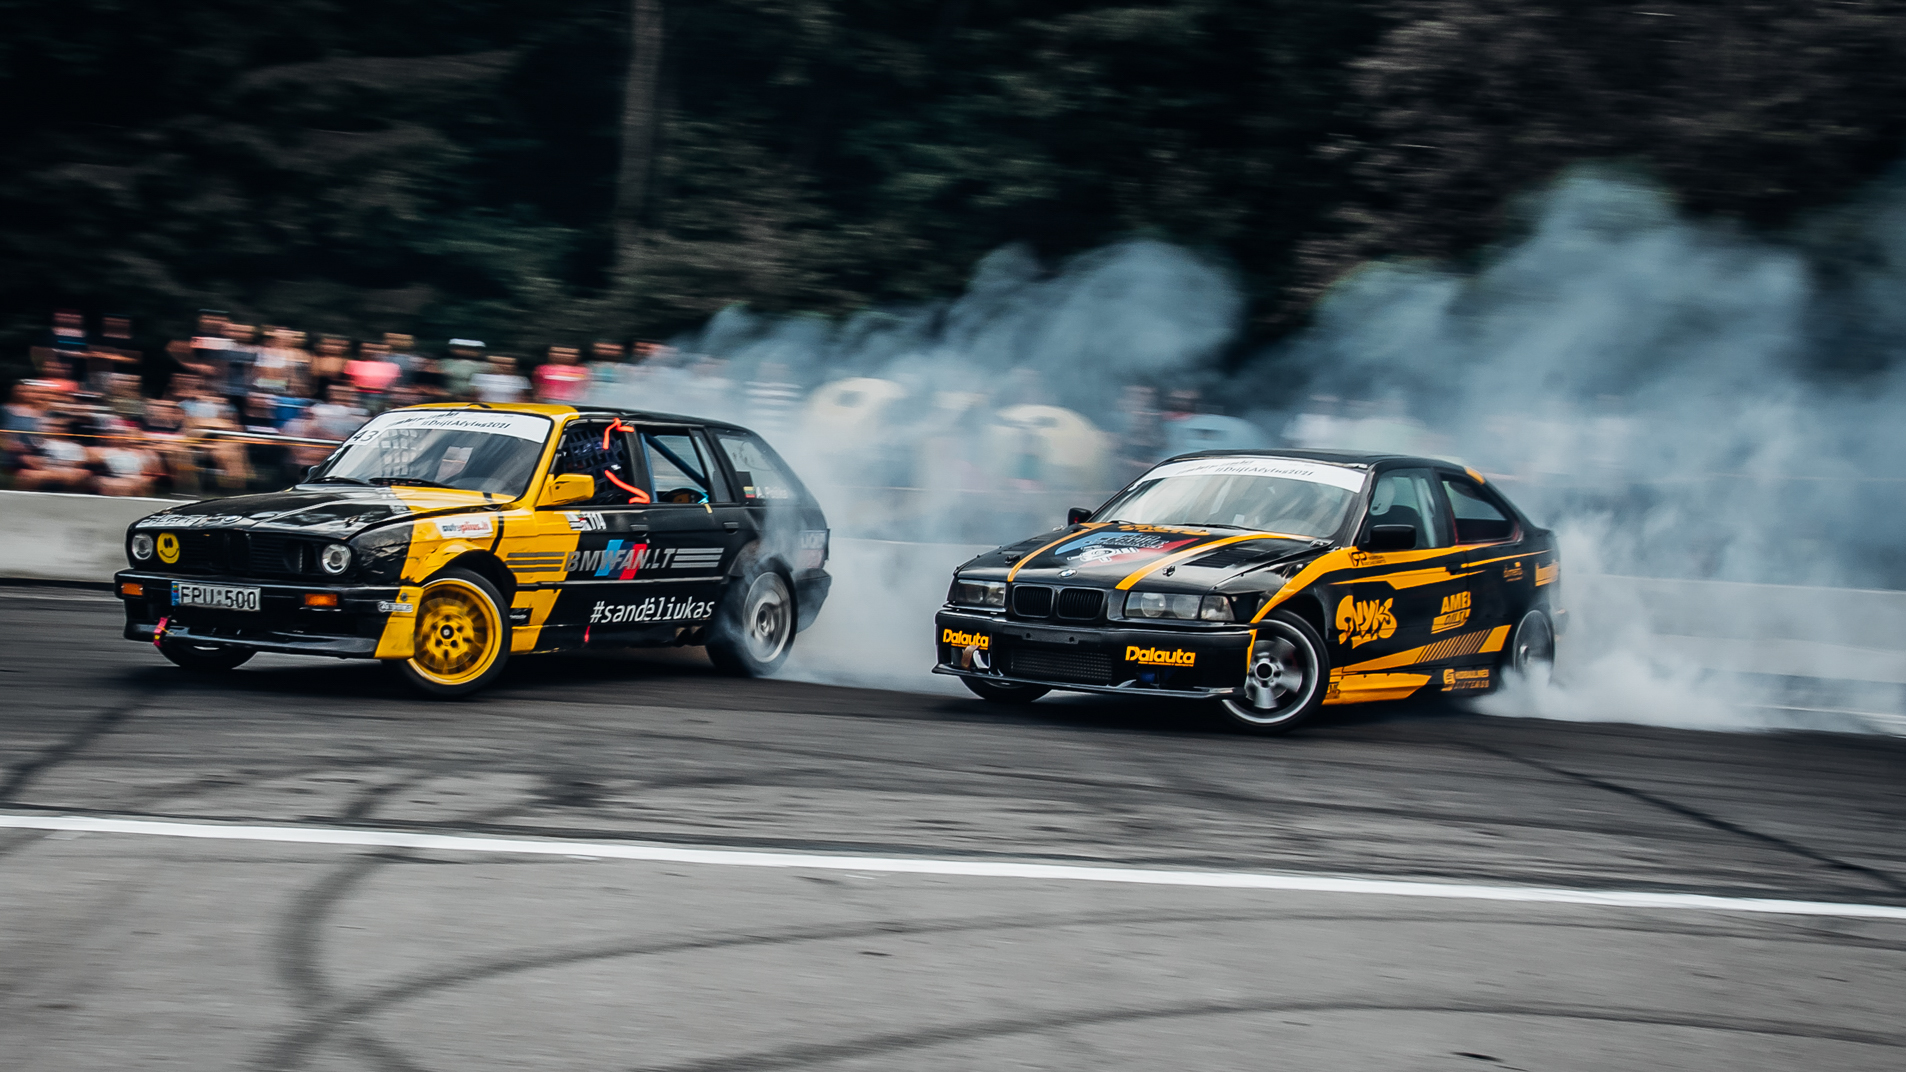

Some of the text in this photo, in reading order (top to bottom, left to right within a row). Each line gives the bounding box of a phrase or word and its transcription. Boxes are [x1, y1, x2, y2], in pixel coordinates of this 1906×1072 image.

[353, 430, 379, 441] 43
[564, 548, 676, 572] BMWFAN.LT
[180, 586, 257, 610] FPU 500
[589, 597, 715, 623] #sandėliukas
[943, 628, 989, 649] Dalauta
[1125, 645, 1196, 666] Dalauta
